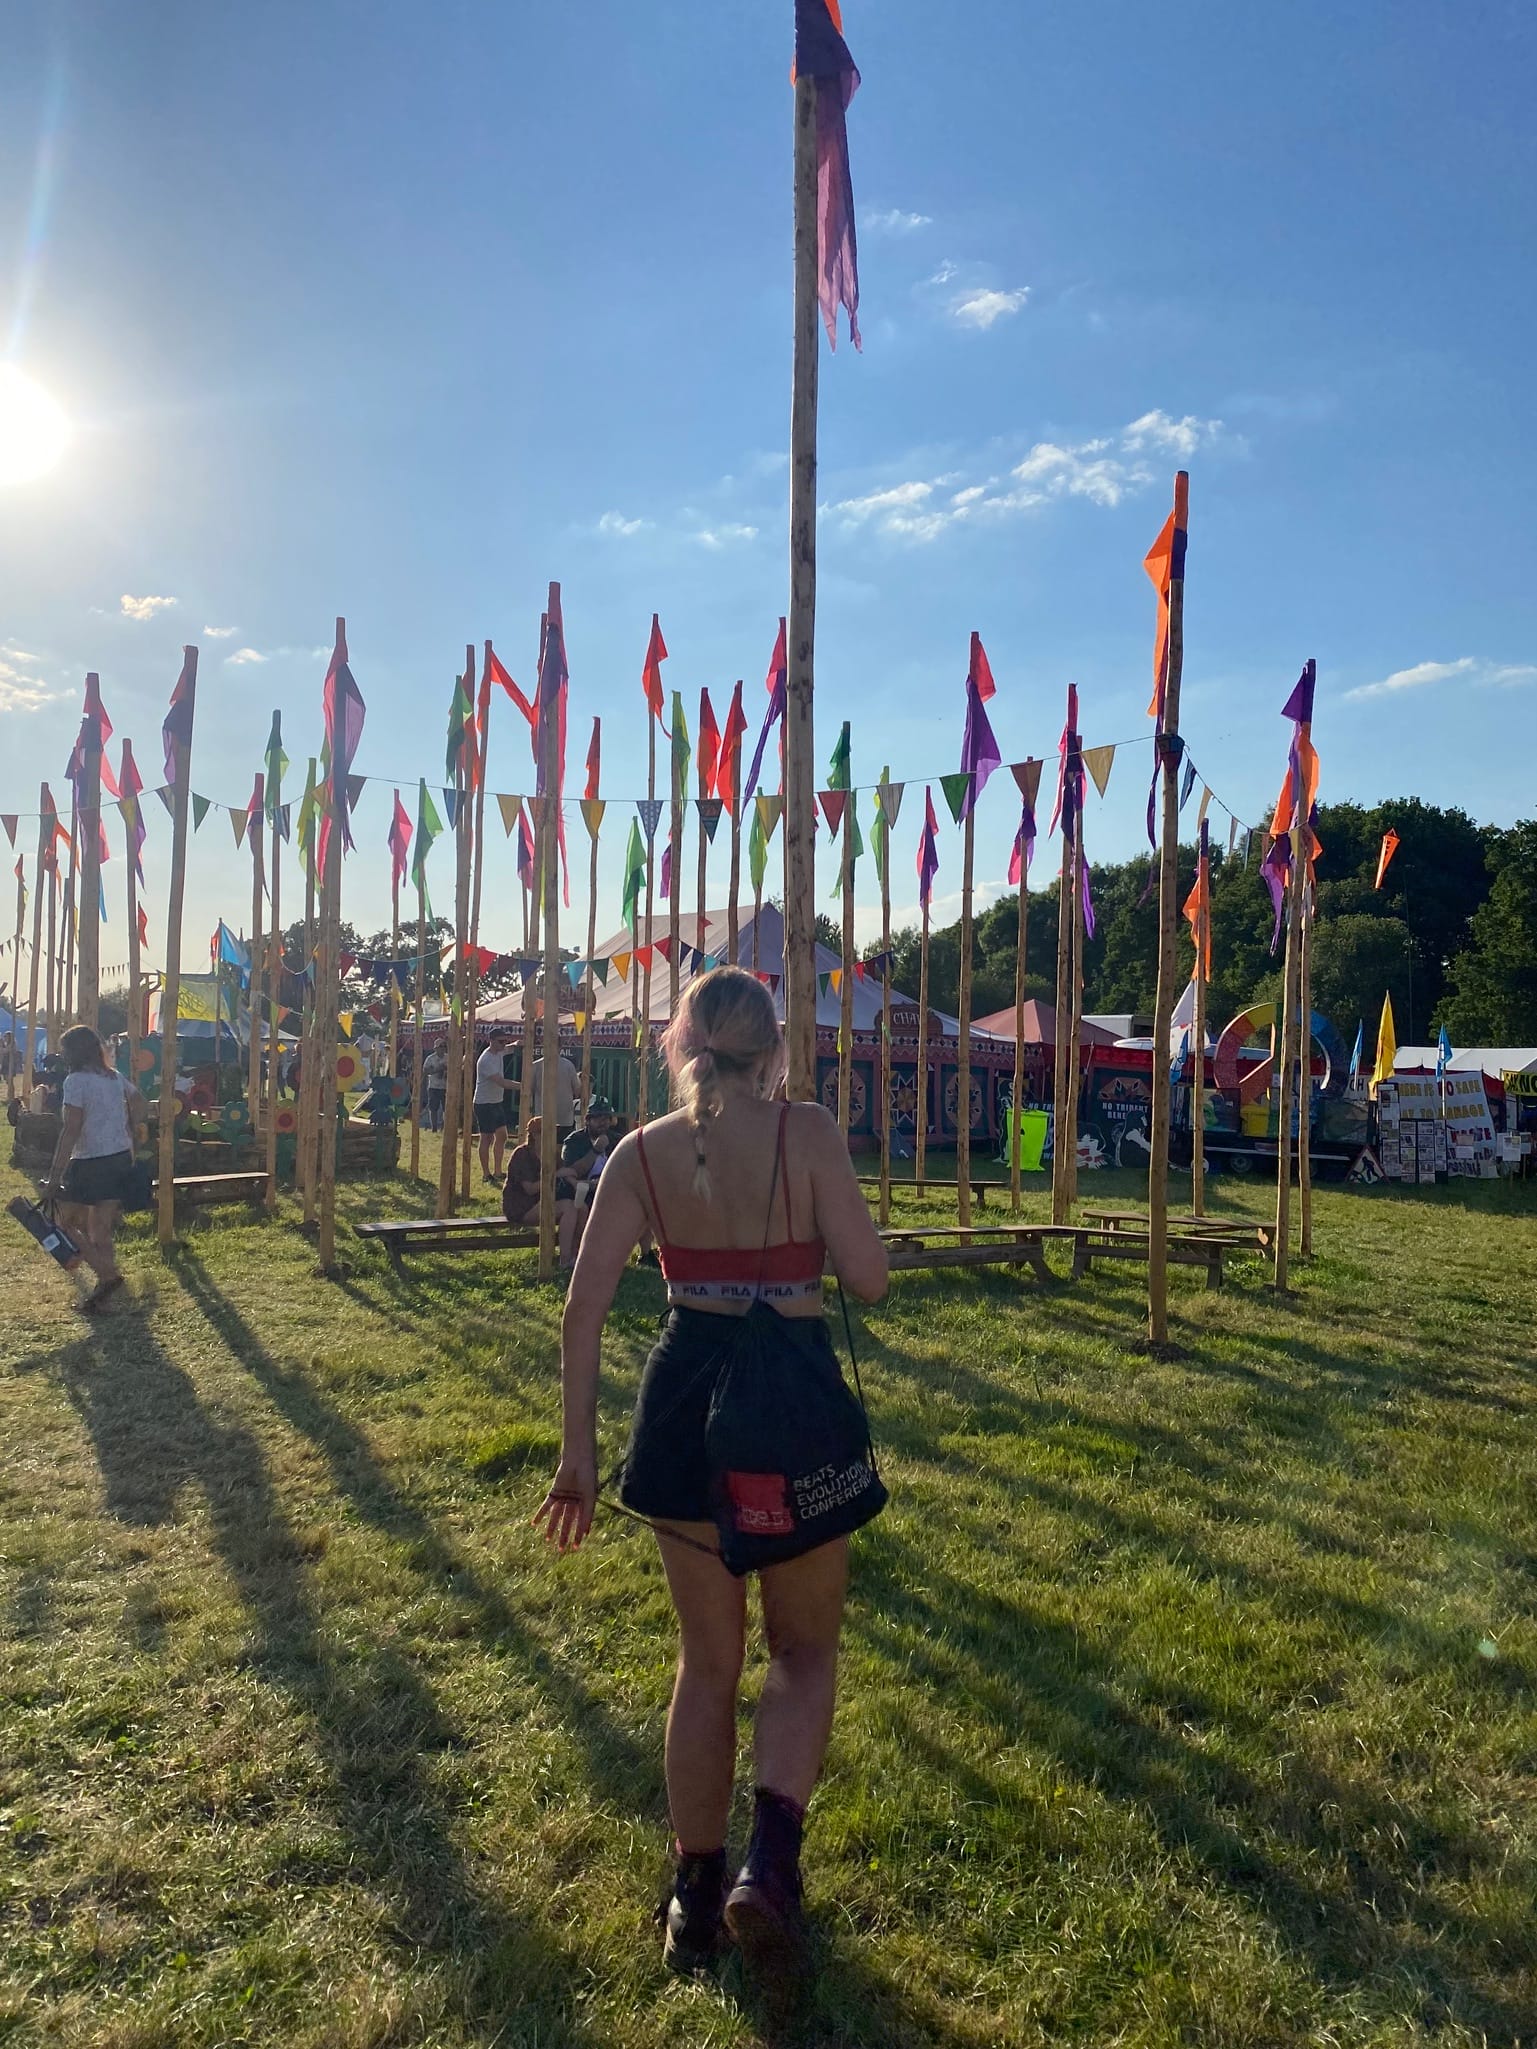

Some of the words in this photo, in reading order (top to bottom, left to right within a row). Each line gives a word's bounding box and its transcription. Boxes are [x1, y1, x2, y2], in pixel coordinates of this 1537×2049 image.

[1102, 1102, 1113, 1111] NO
[683, 1285, 709, 1297] FILA
[721, 1285, 751, 1297] FILA
[765, 1285, 793, 1297] FILA
[793, 1463, 836, 1492] BEATS
